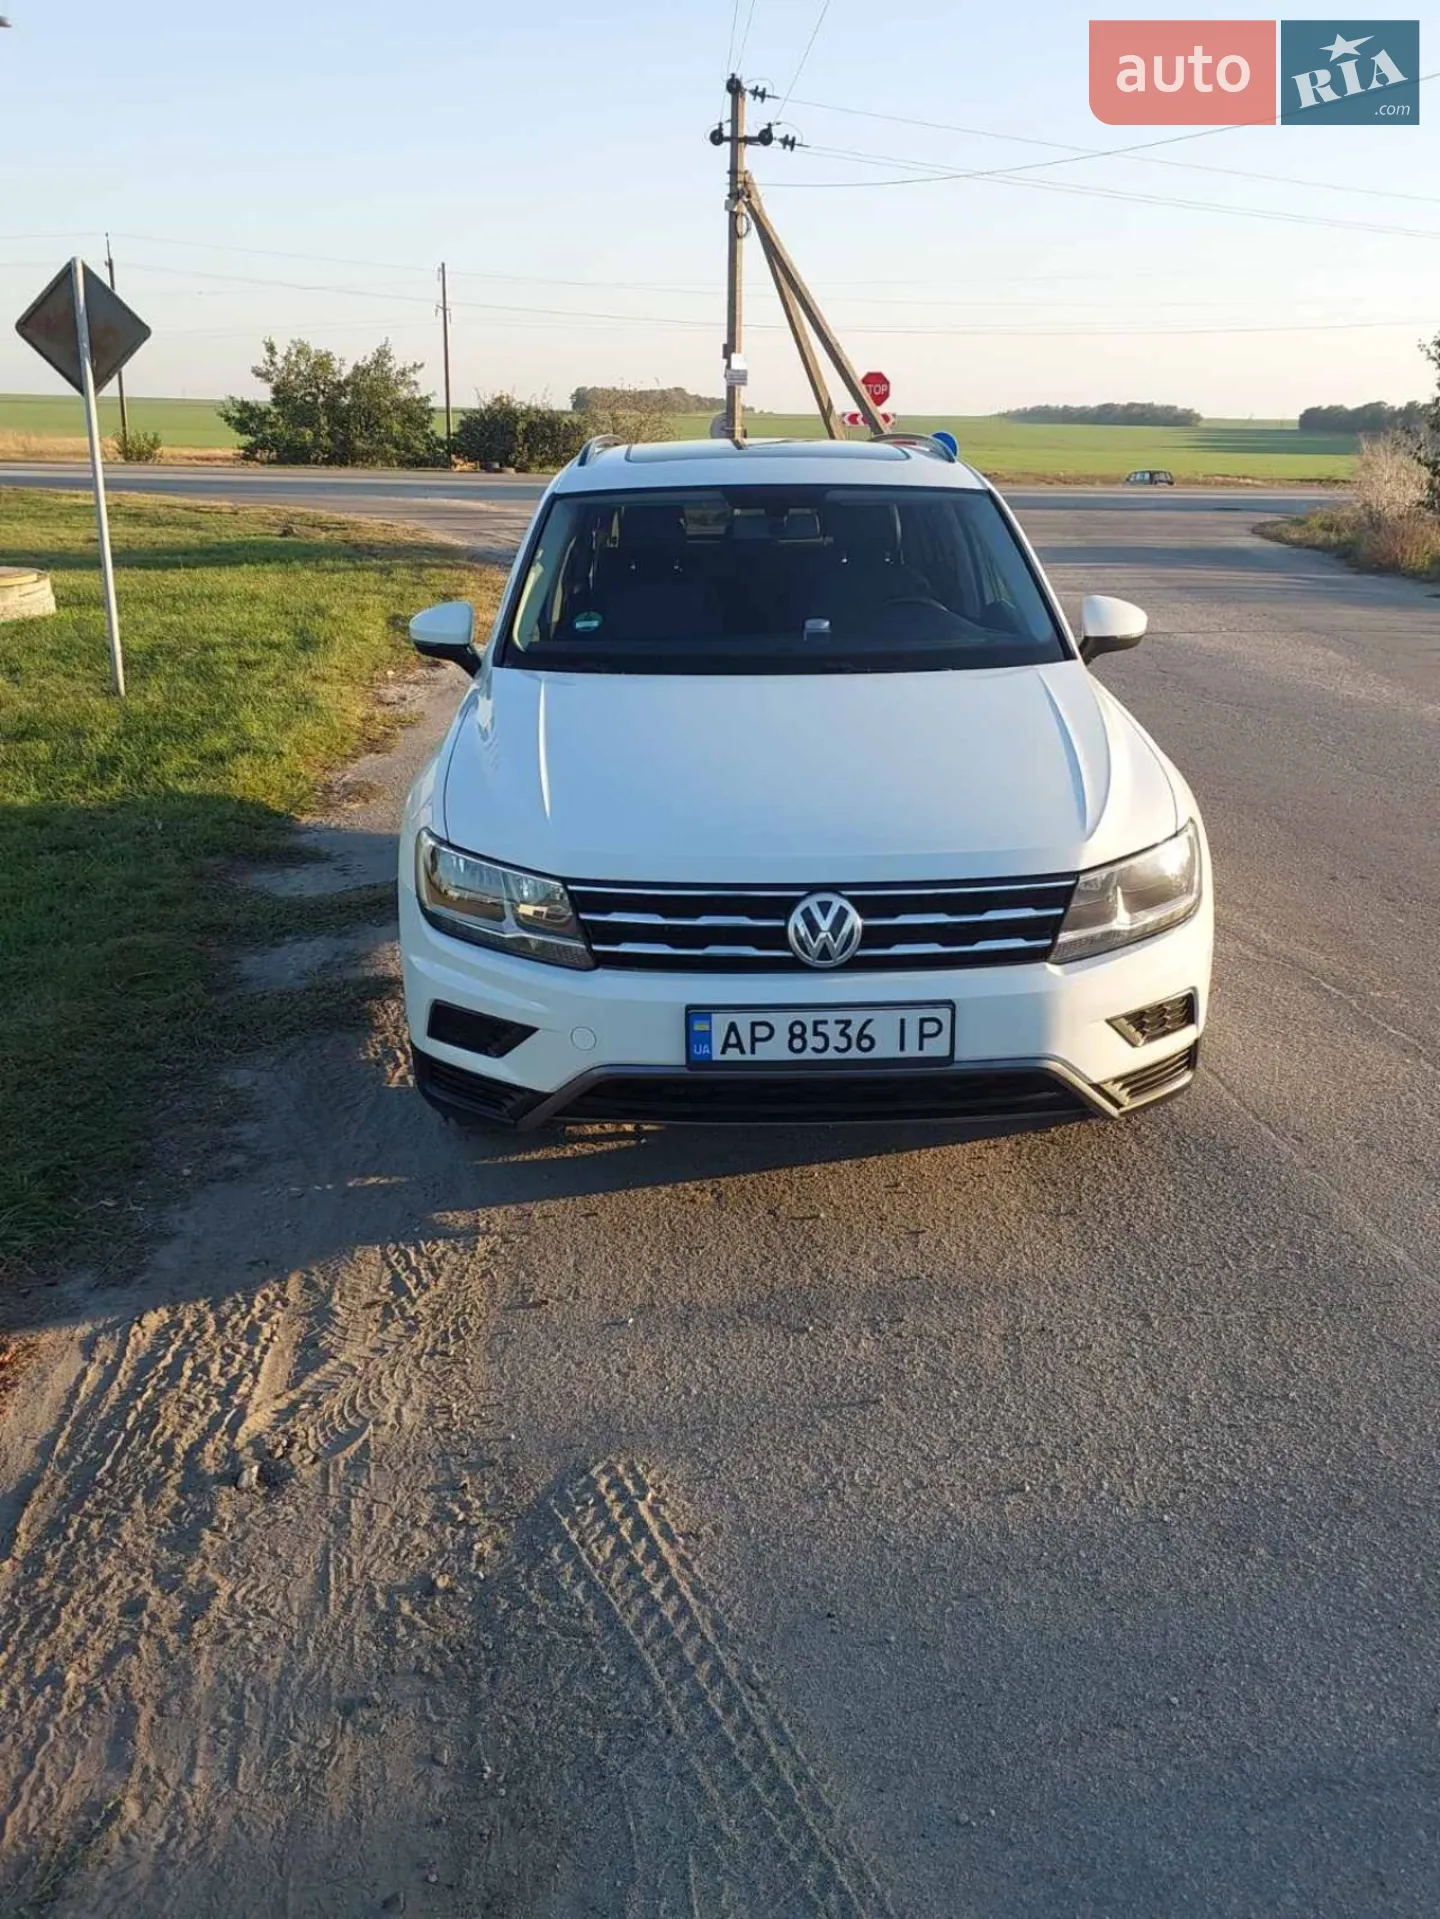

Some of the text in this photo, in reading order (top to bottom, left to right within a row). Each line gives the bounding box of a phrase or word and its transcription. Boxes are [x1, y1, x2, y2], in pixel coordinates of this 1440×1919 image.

[866, 383, 888, 396] TOP
[790, 894, 861, 967] VW
[719, 1016, 943, 1056] AP 8536 IP
[693, 1044, 710, 1055] UA
